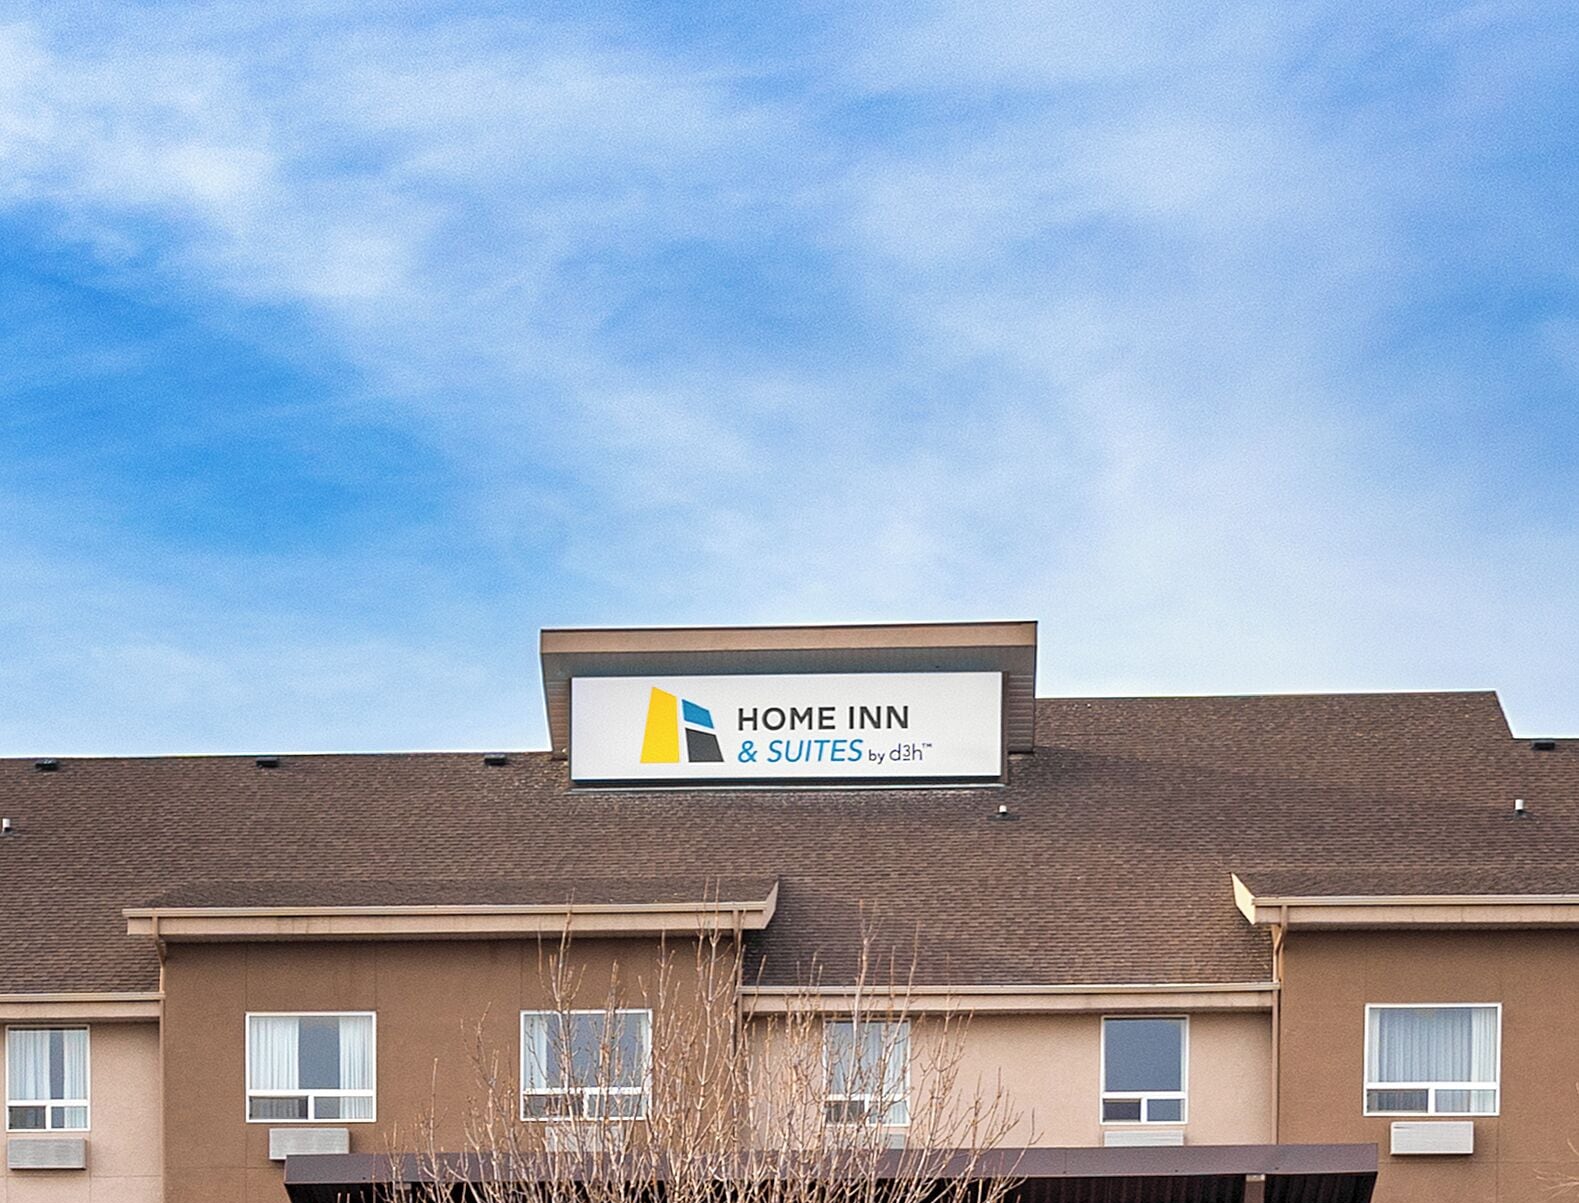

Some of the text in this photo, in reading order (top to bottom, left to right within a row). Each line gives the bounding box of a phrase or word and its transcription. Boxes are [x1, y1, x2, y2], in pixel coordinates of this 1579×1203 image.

[738, 705, 909, 731] HOME INN
[737, 740, 758, 763] &
[766, 739, 864, 763] SUITES
[868, 750, 886, 765] by
